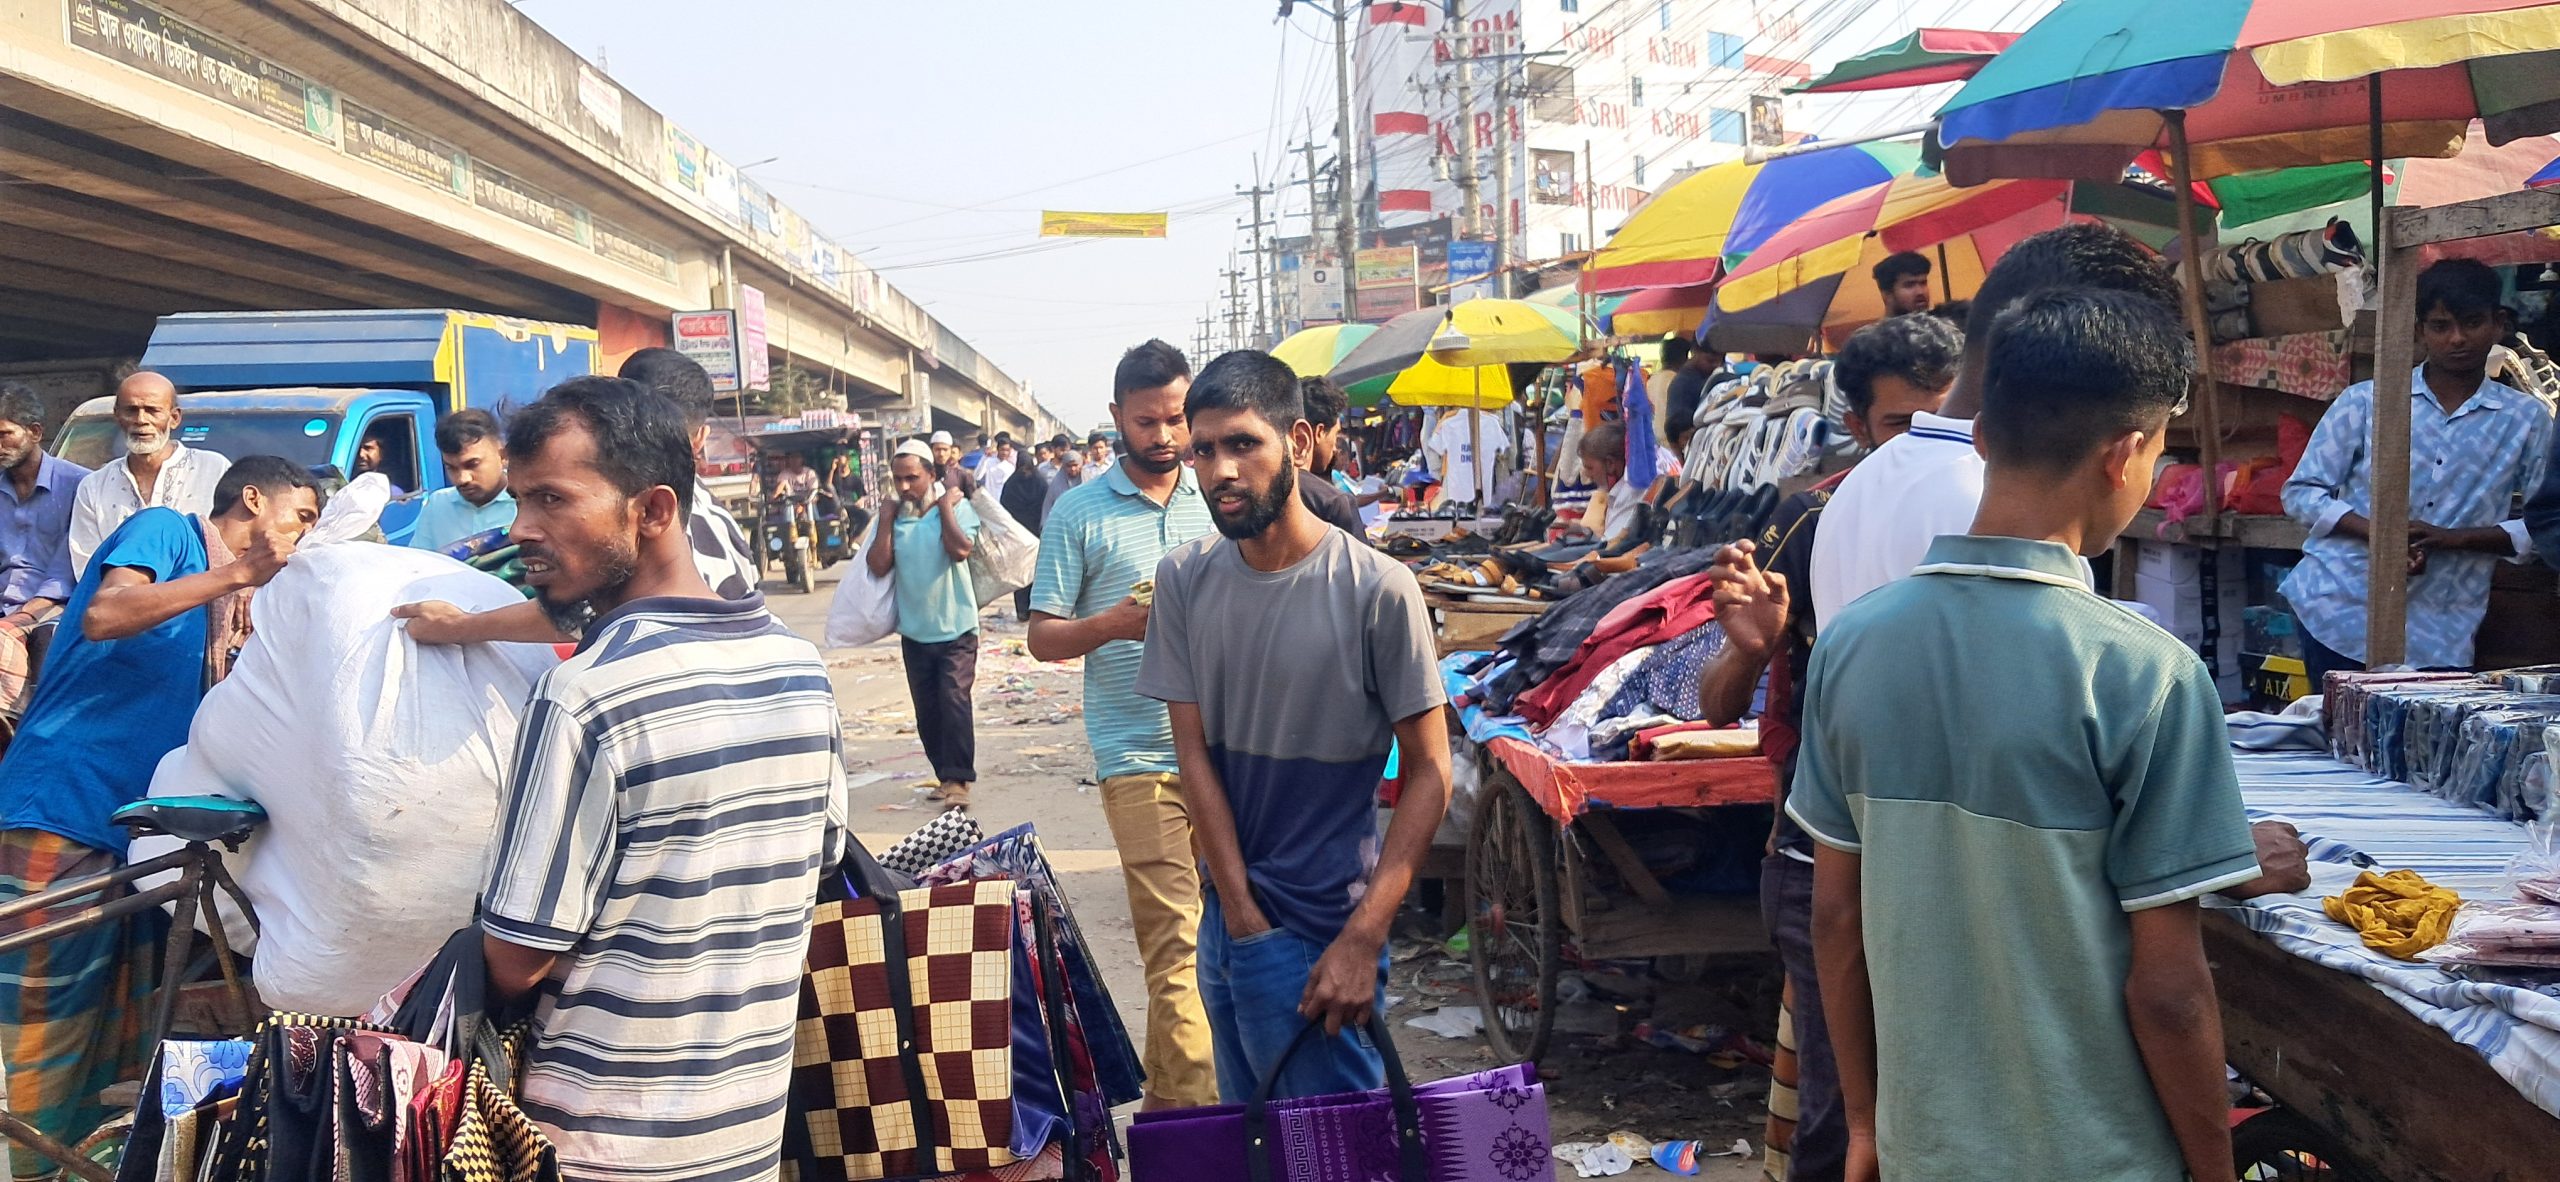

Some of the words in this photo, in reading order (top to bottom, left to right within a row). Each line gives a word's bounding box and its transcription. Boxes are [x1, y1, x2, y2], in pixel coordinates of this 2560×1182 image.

[1562, 21, 1615, 58] KSRM
[1648, 36, 1697, 68] KSRM
[1574, 95, 1627, 130] KSRM
[1652, 107, 1701, 140] KSRM
[1573, 180, 1627, 212] KSRM
